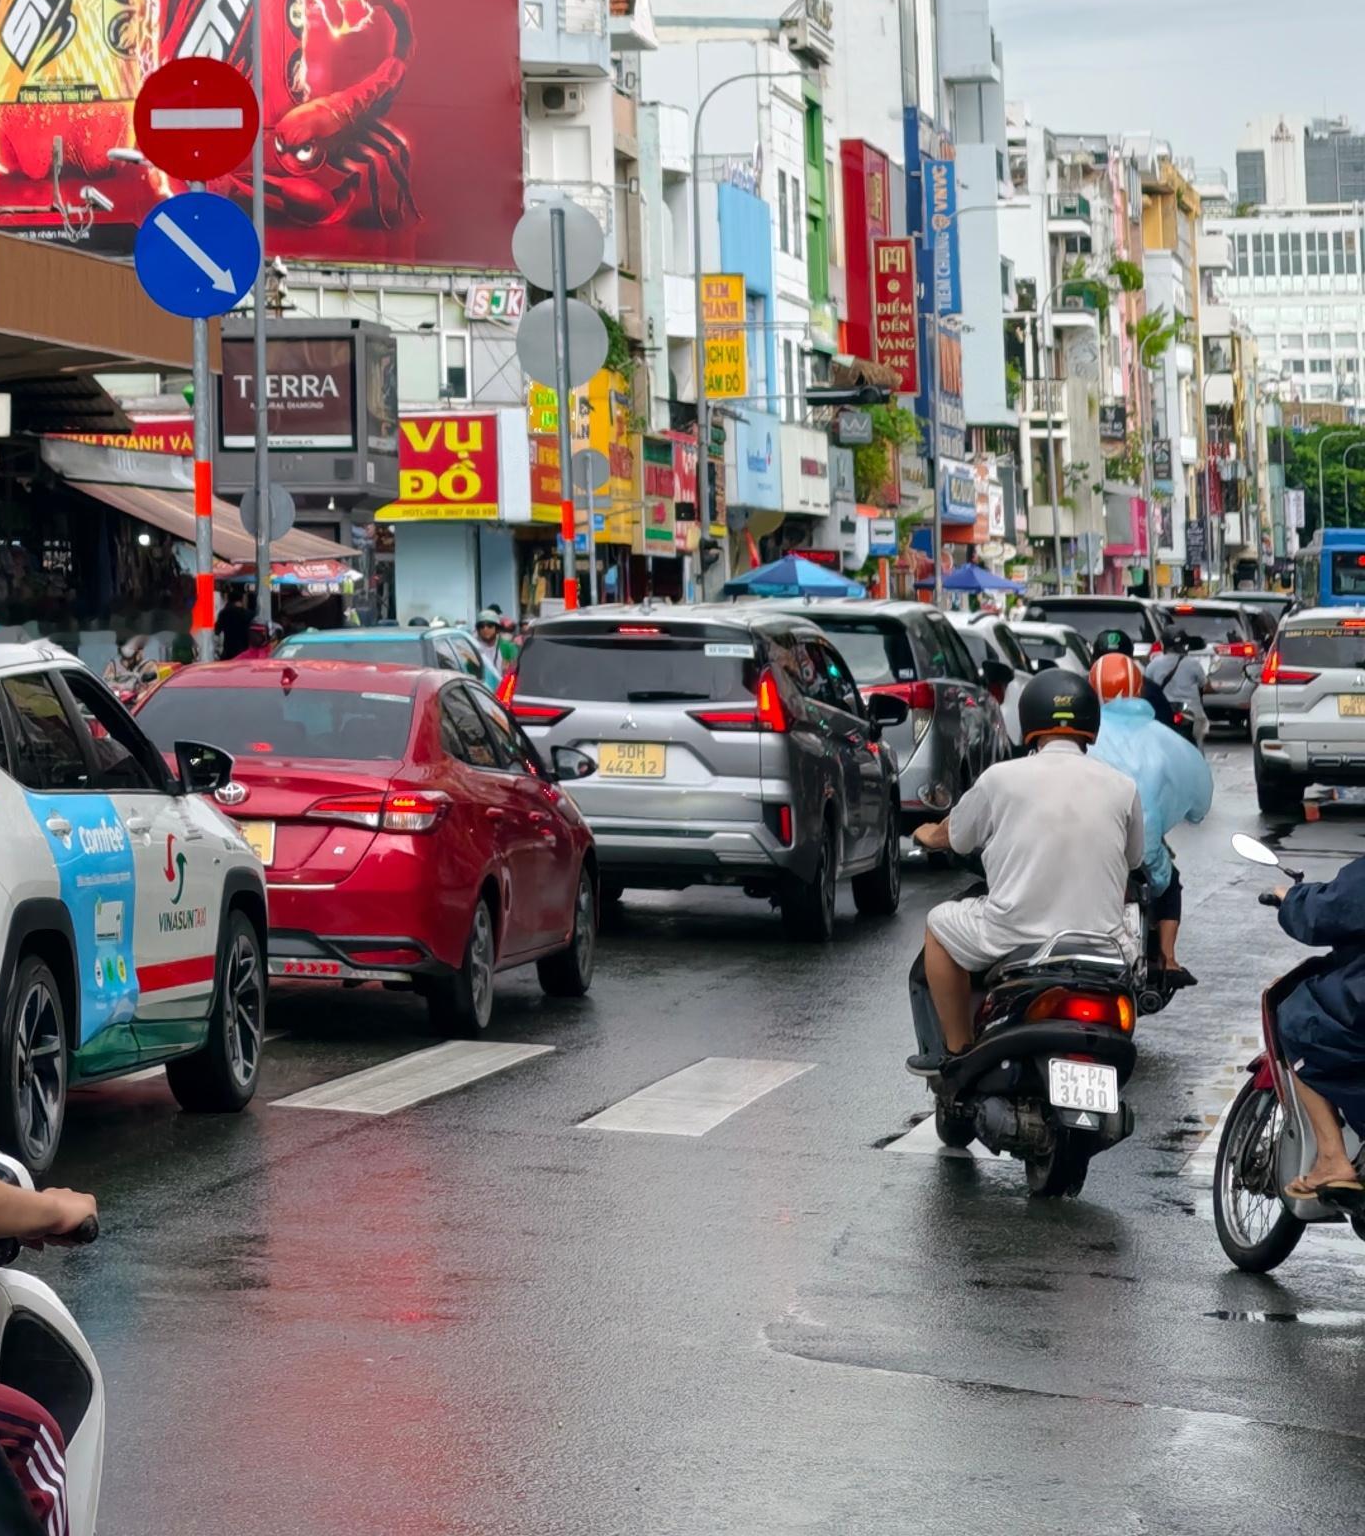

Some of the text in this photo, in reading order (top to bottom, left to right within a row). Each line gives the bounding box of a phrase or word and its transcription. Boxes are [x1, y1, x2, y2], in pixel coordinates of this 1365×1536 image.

[880, 315, 910, 332] ĐẾN
[876, 334, 916, 351] VÀNG
[234, 374, 340, 399] TERRA
[399, 420, 483, 459] VỤ
